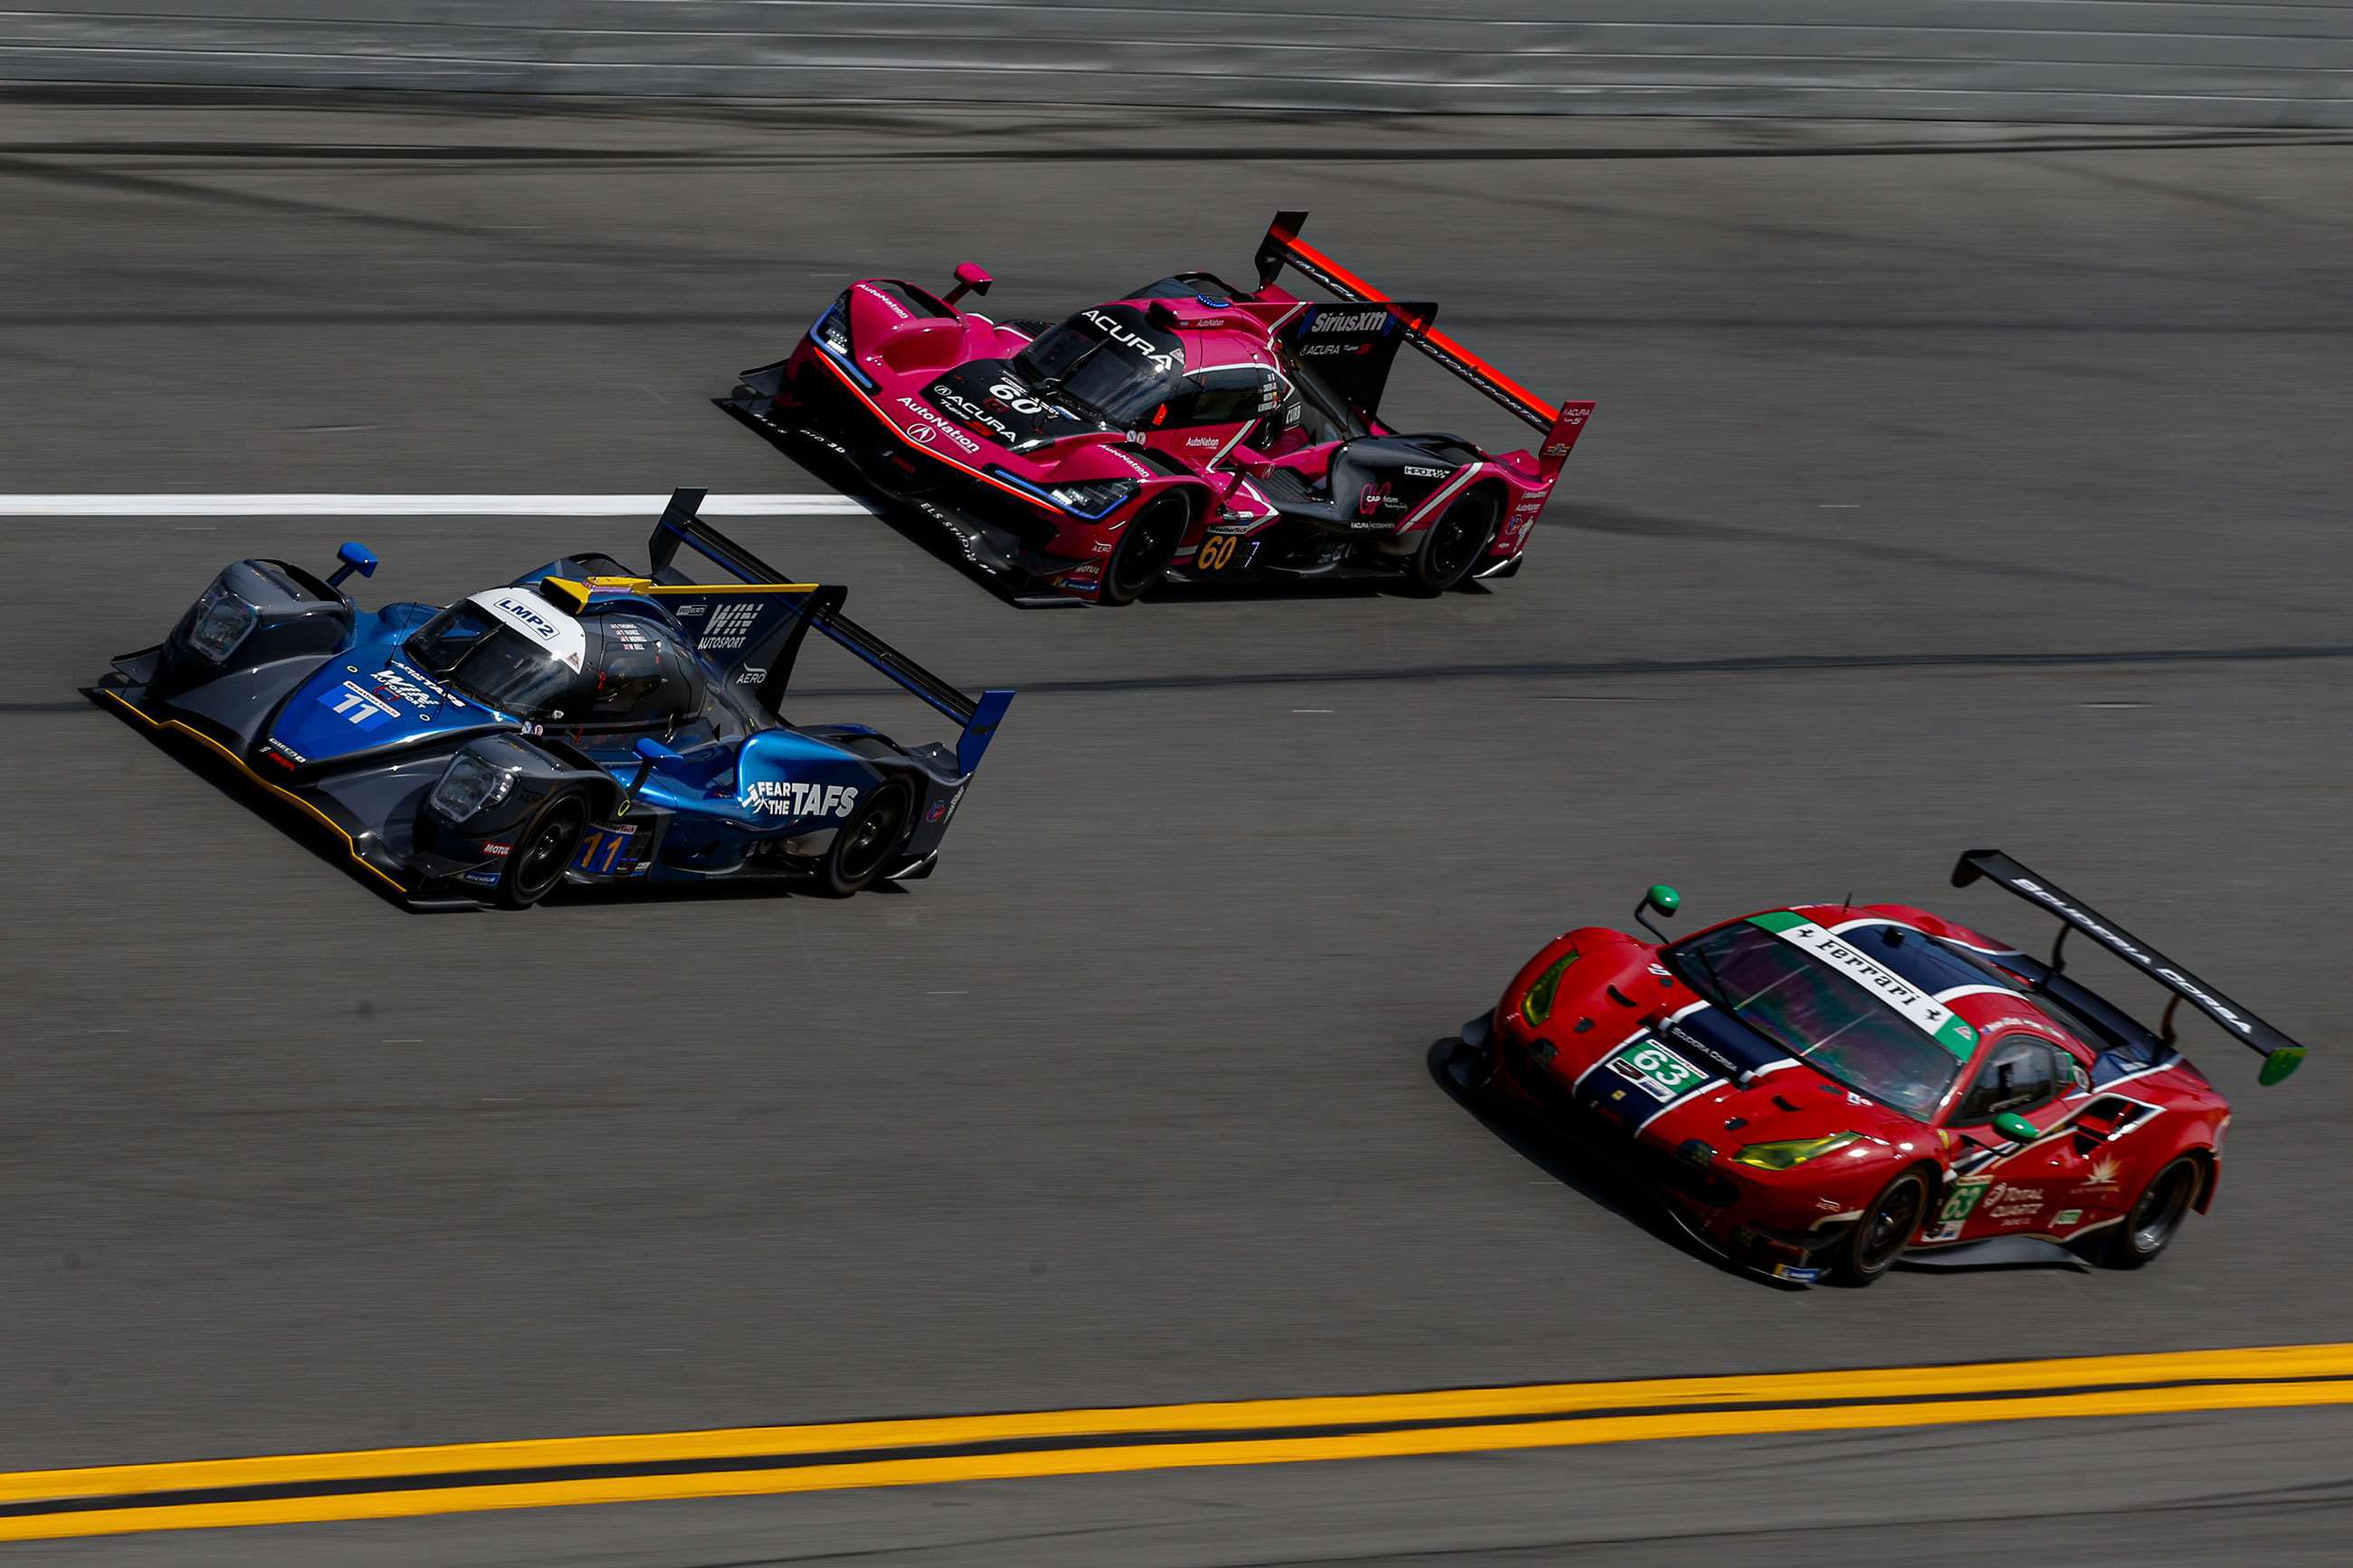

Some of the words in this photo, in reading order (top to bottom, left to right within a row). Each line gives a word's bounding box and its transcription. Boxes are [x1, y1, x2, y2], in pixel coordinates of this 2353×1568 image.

[855, 283, 909, 318] AutoNation
[1311, 311, 1387, 333] SiriusXM
[1081, 309, 1173, 371] ACURA
[989, 384, 1043, 414] 60
[896, 396, 980, 453] AutoNation
[947, 395, 1017, 443] ACURA
[1198, 535, 1237, 570] 60
[499, 600, 555, 637] LMP2
[697, 636, 747, 650] AUTOSPORT
[369, 673, 426, 708] AUTOSPORT
[736, 673, 767, 684] AERO
[332, 692, 380, 724] 11
[346, 681, 398, 716] WeatherTech
[757, 782, 792, 796] FEAR
[791, 783, 859, 818] TAFS
[768, 801, 790, 814] THE
[584, 832, 624, 872] 11
[1815, 938, 1920, 1006] Ferrari
[2010, 879, 2152, 965] SCUDERIA
[2156, 967, 2253, 1035] CORSA
[1634, 1050, 1690, 1086] 63
[1939, 1186, 1982, 1221] 63
